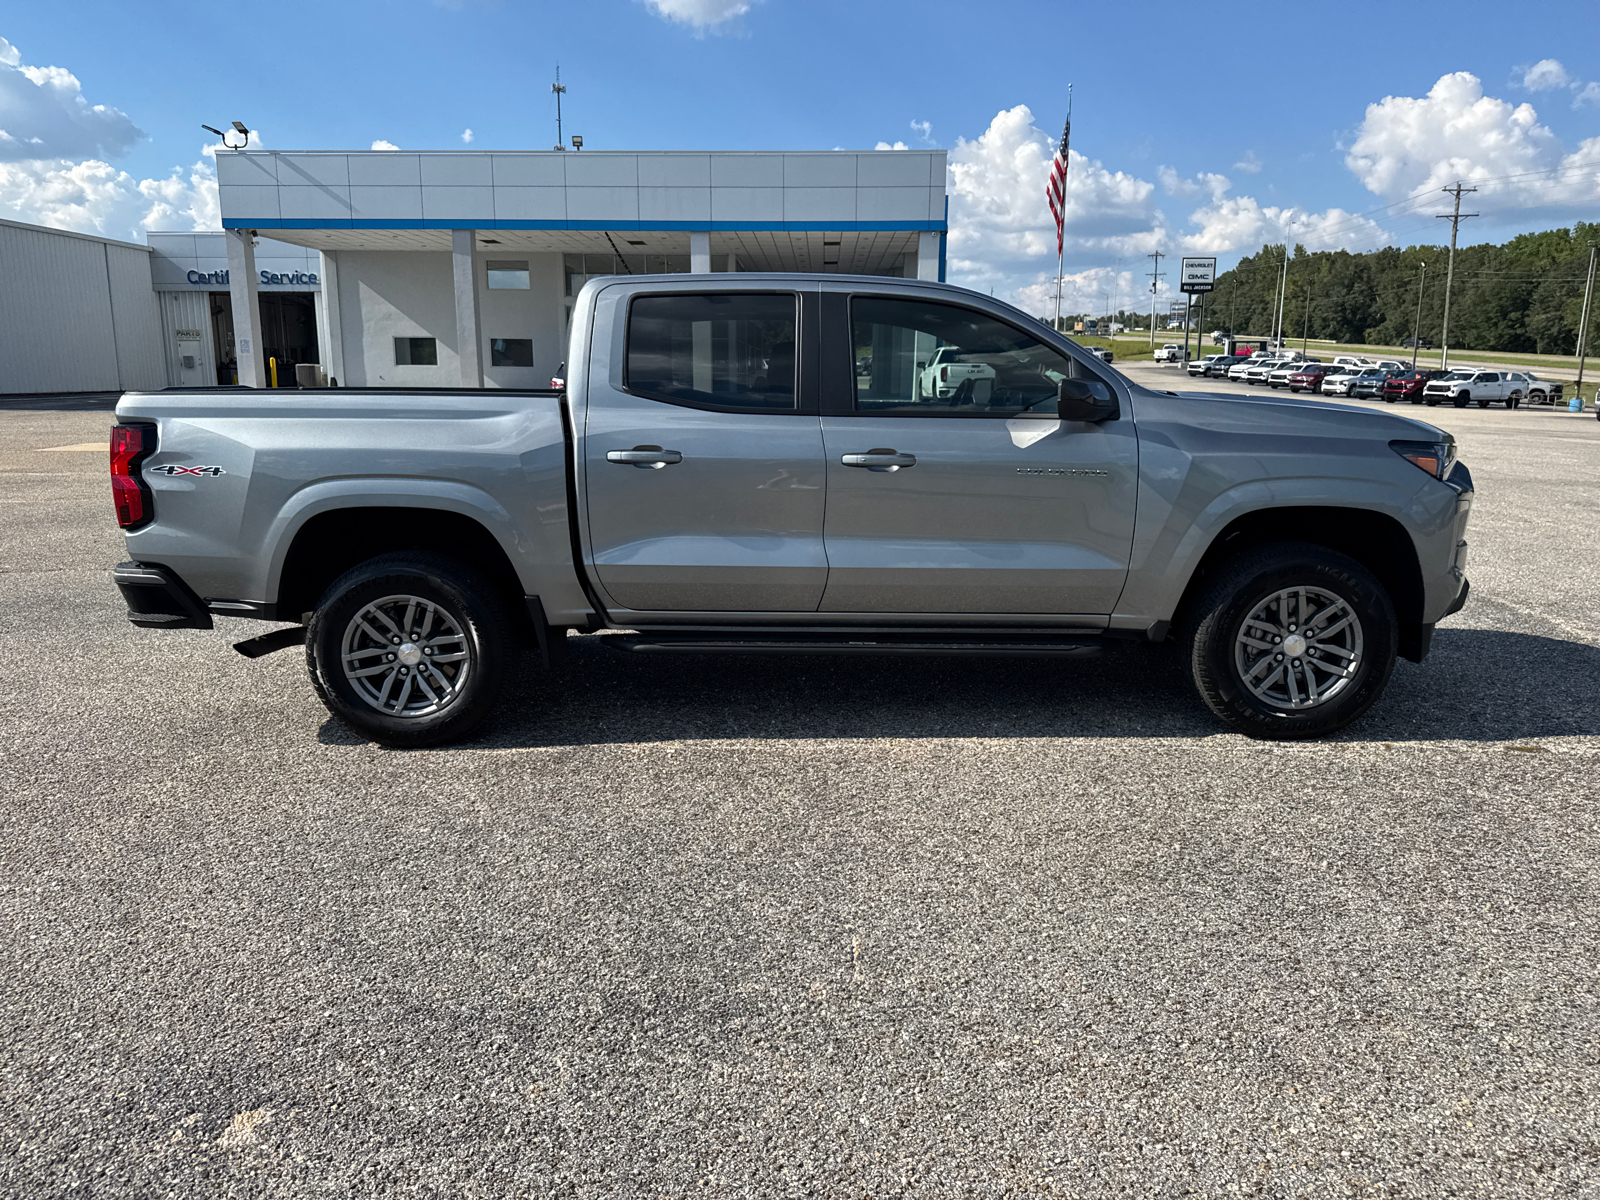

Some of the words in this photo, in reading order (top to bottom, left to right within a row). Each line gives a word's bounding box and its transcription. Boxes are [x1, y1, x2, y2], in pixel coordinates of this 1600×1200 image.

[187, 269, 230, 284] Certif
[260, 270, 318, 285] Service
[1016, 468, 1108, 477] COLORADO
